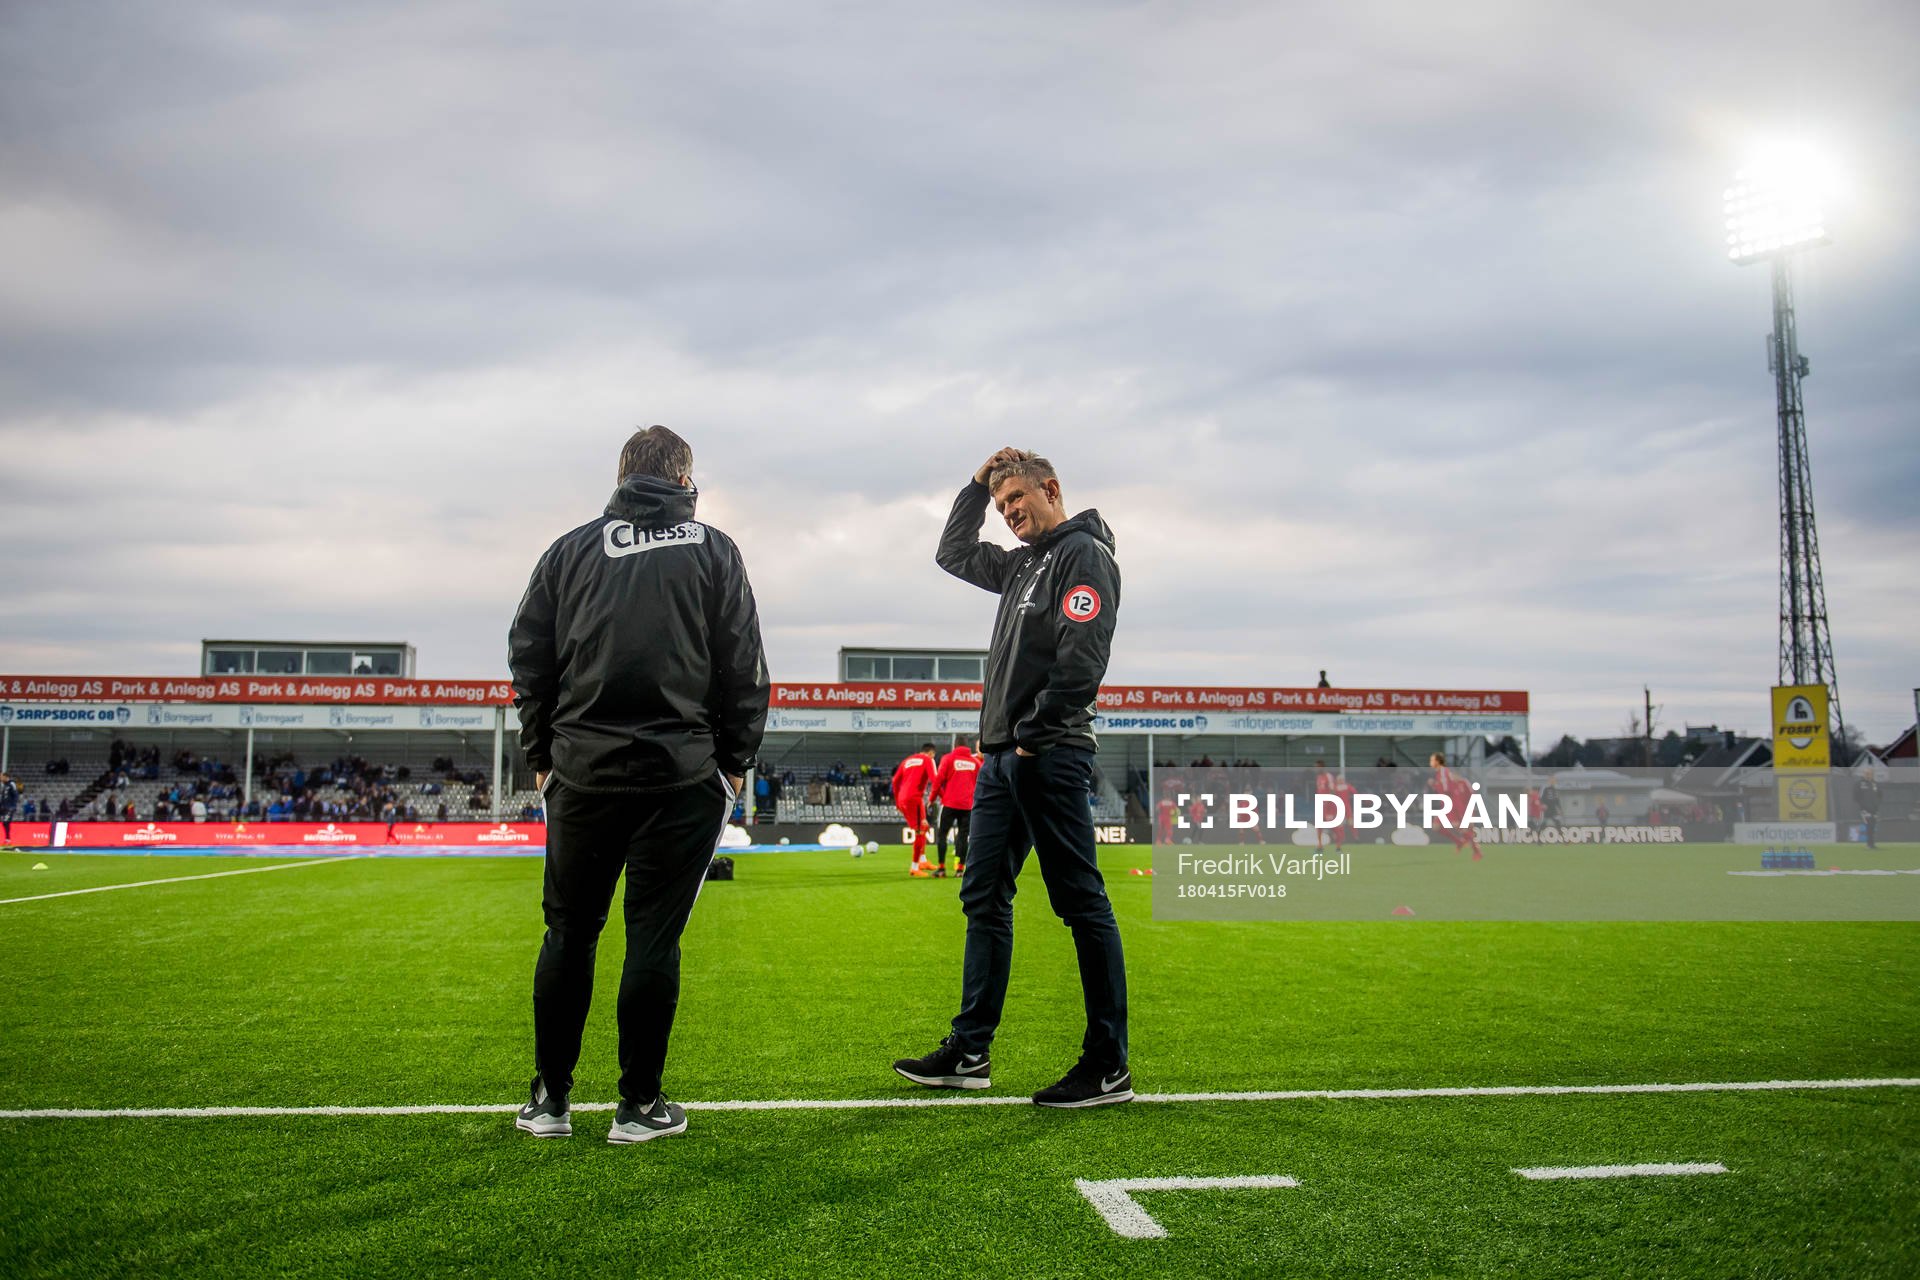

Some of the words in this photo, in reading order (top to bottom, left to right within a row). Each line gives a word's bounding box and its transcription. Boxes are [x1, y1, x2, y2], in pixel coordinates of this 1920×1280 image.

[611, 525, 687, 548] Chess
[1072, 596, 1092, 611] 12
[11, 681, 21, 693] &
[26, 681, 78, 697] Anlegg
[82, 681, 103, 694] AS
[112, 682, 145, 695] Park
[150, 682, 160, 695] &
[164, 682, 215, 697] Anlegg
[219, 683, 240, 695] AS
[248, 683, 282, 696] Park
[286, 683, 296, 696] &
[300, 684, 350, 699] Anlegg
[355, 684, 376, 697] AS
[384, 684, 416, 697] Park
[421, 684, 431, 697] &
[435, 684, 484, 700] Anlegg
[488, 685, 509, 698] AS
[778, 688, 809, 701] Park
[813, 688, 822, 701] &
[827, 688, 874, 703] Anlegg
[877, 689, 896, 701] AS
[905, 688, 936, 701] Park
[939, 689, 949, 701] &
[952, 689, 983, 702] Anle
[1096, 693, 1122, 705] egg
[1126, 692, 1145, 703] AS
[1152, 692, 1182, 703] Park
[1185, 692, 1195, 703] &
[1199, 692, 1244, 706] Anlegg
[1247, 692, 1265, 704] AS
[1273, 693, 1303, 704] Park
[1305, 693, 1315, 704] &
[1319, 693, 1363, 707] Anlegg
[1366, 693, 1384, 705] AS
[1391, 694, 1421, 706] Park
[1424, 694, 1432, 706] &
[1436, 694, 1480, 708] Anlegg
[1483, 695, 1502, 707] AS
[17, 709, 95, 720] SARPSBORG
[98, 709, 115, 720] 08
[164, 712, 212, 724] Borregaard
[255, 713, 303, 725] Borregaard
[346, 713, 393, 726] Borregaard
[435, 714, 482, 726] Borregaard
[781, 717, 826, 729] Borregaard
[867, 718, 911, 730] Borregaard
[951, 719, 979, 729] Borreg
[1108, 718, 1177, 728] SARPSBORG
[1180, 718, 1194, 728] 08
[1604, 827, 1683, 843] PARTNER
